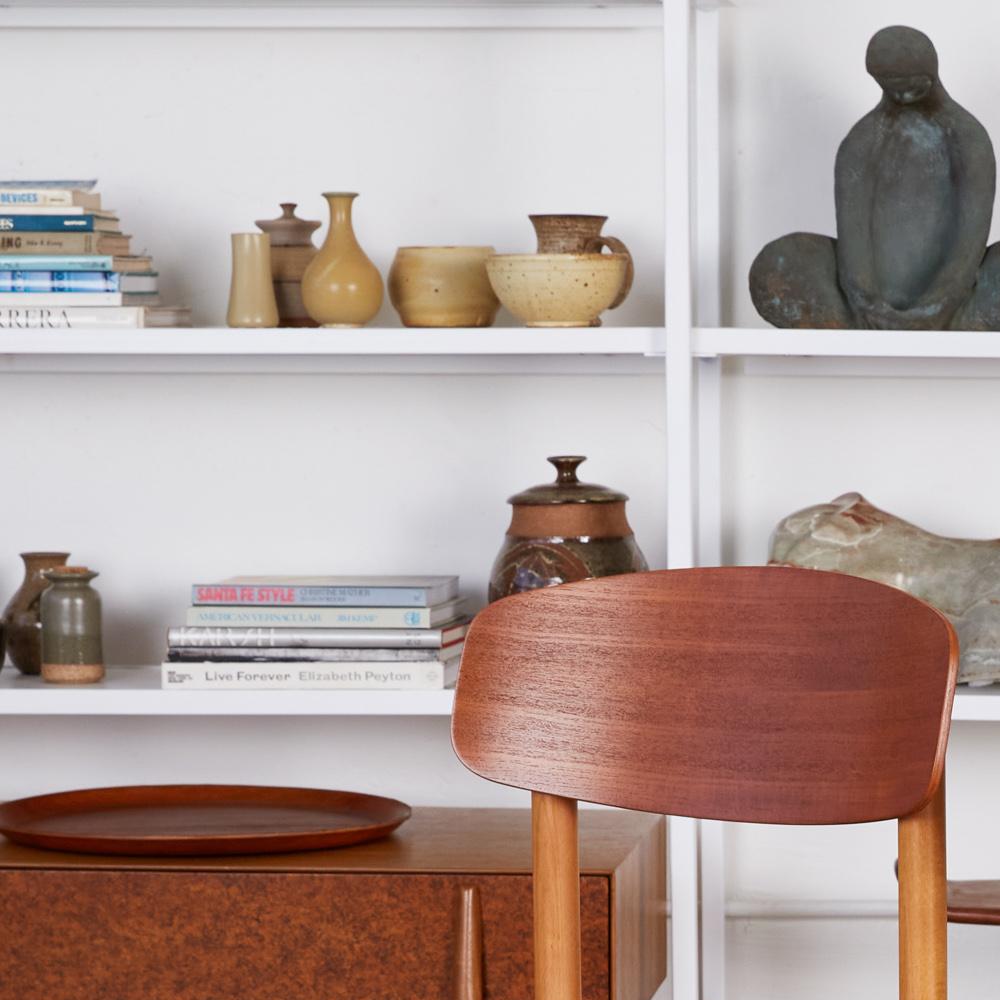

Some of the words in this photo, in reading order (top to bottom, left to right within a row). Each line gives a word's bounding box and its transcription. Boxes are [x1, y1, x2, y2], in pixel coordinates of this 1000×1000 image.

[197, 587, 238, 602] SANTA
[240, 587, 255, 602] FE
[257, 587, 295, 602] STYLE
[181, 627, 275, 646] KARSH
[205, 671, 233, 681] Live
[236, 671, 291, 681] Forever
[298, 671, 362, 681] Elizabeth
[364, 671, 412, 683] Peyton
